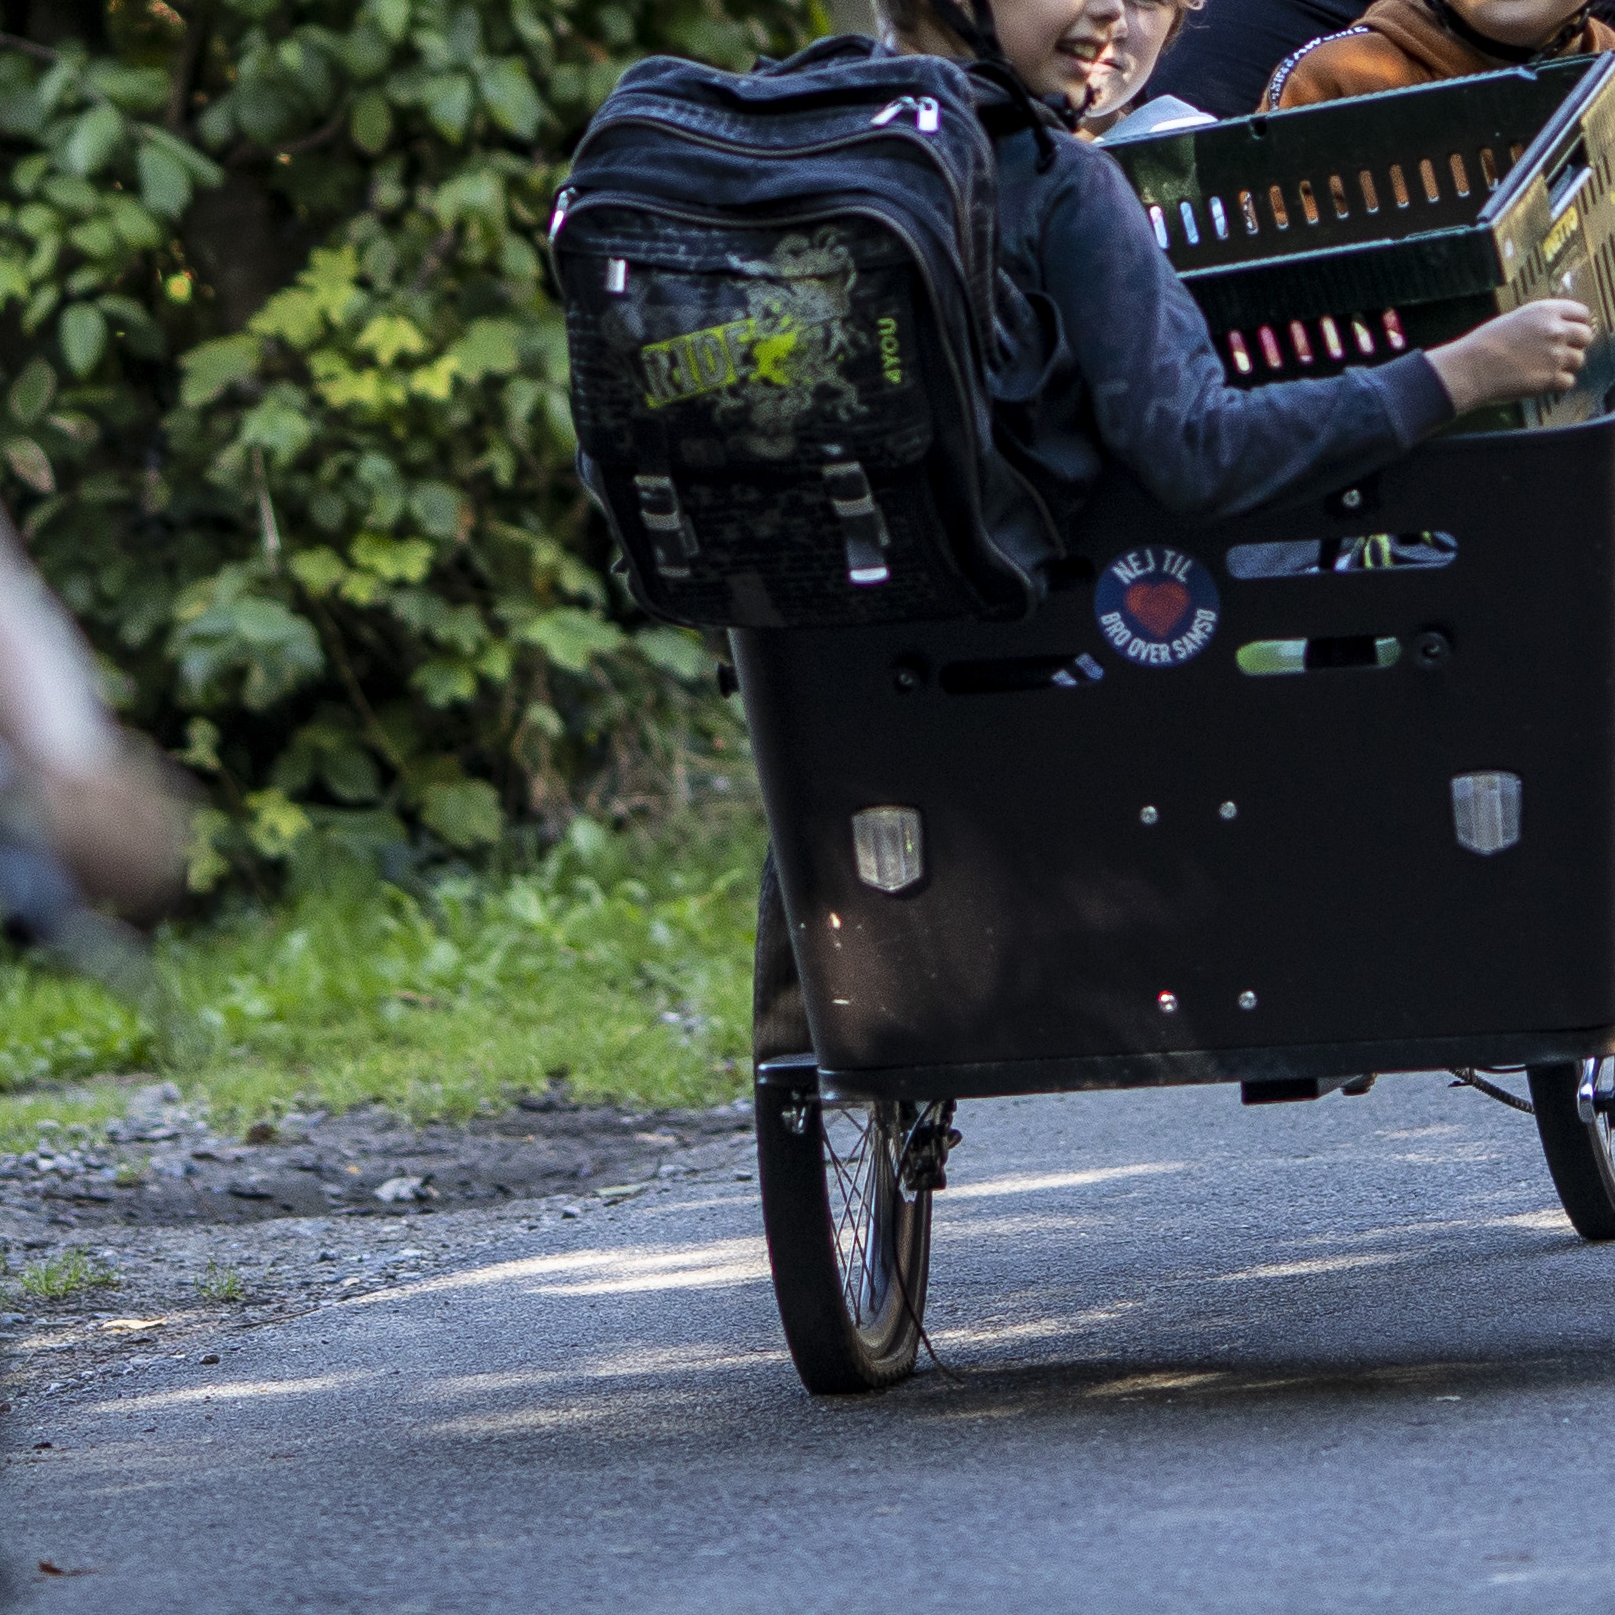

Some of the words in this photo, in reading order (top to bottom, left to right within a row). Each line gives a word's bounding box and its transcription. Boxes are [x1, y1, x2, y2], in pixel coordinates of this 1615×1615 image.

[1112, 548, 1156, 585] NEJ
[1162, 549, 1192, 584] TIL
[1100, 611, 1133, 647] BRO
[1126, 636, 1172, 664] OVER
